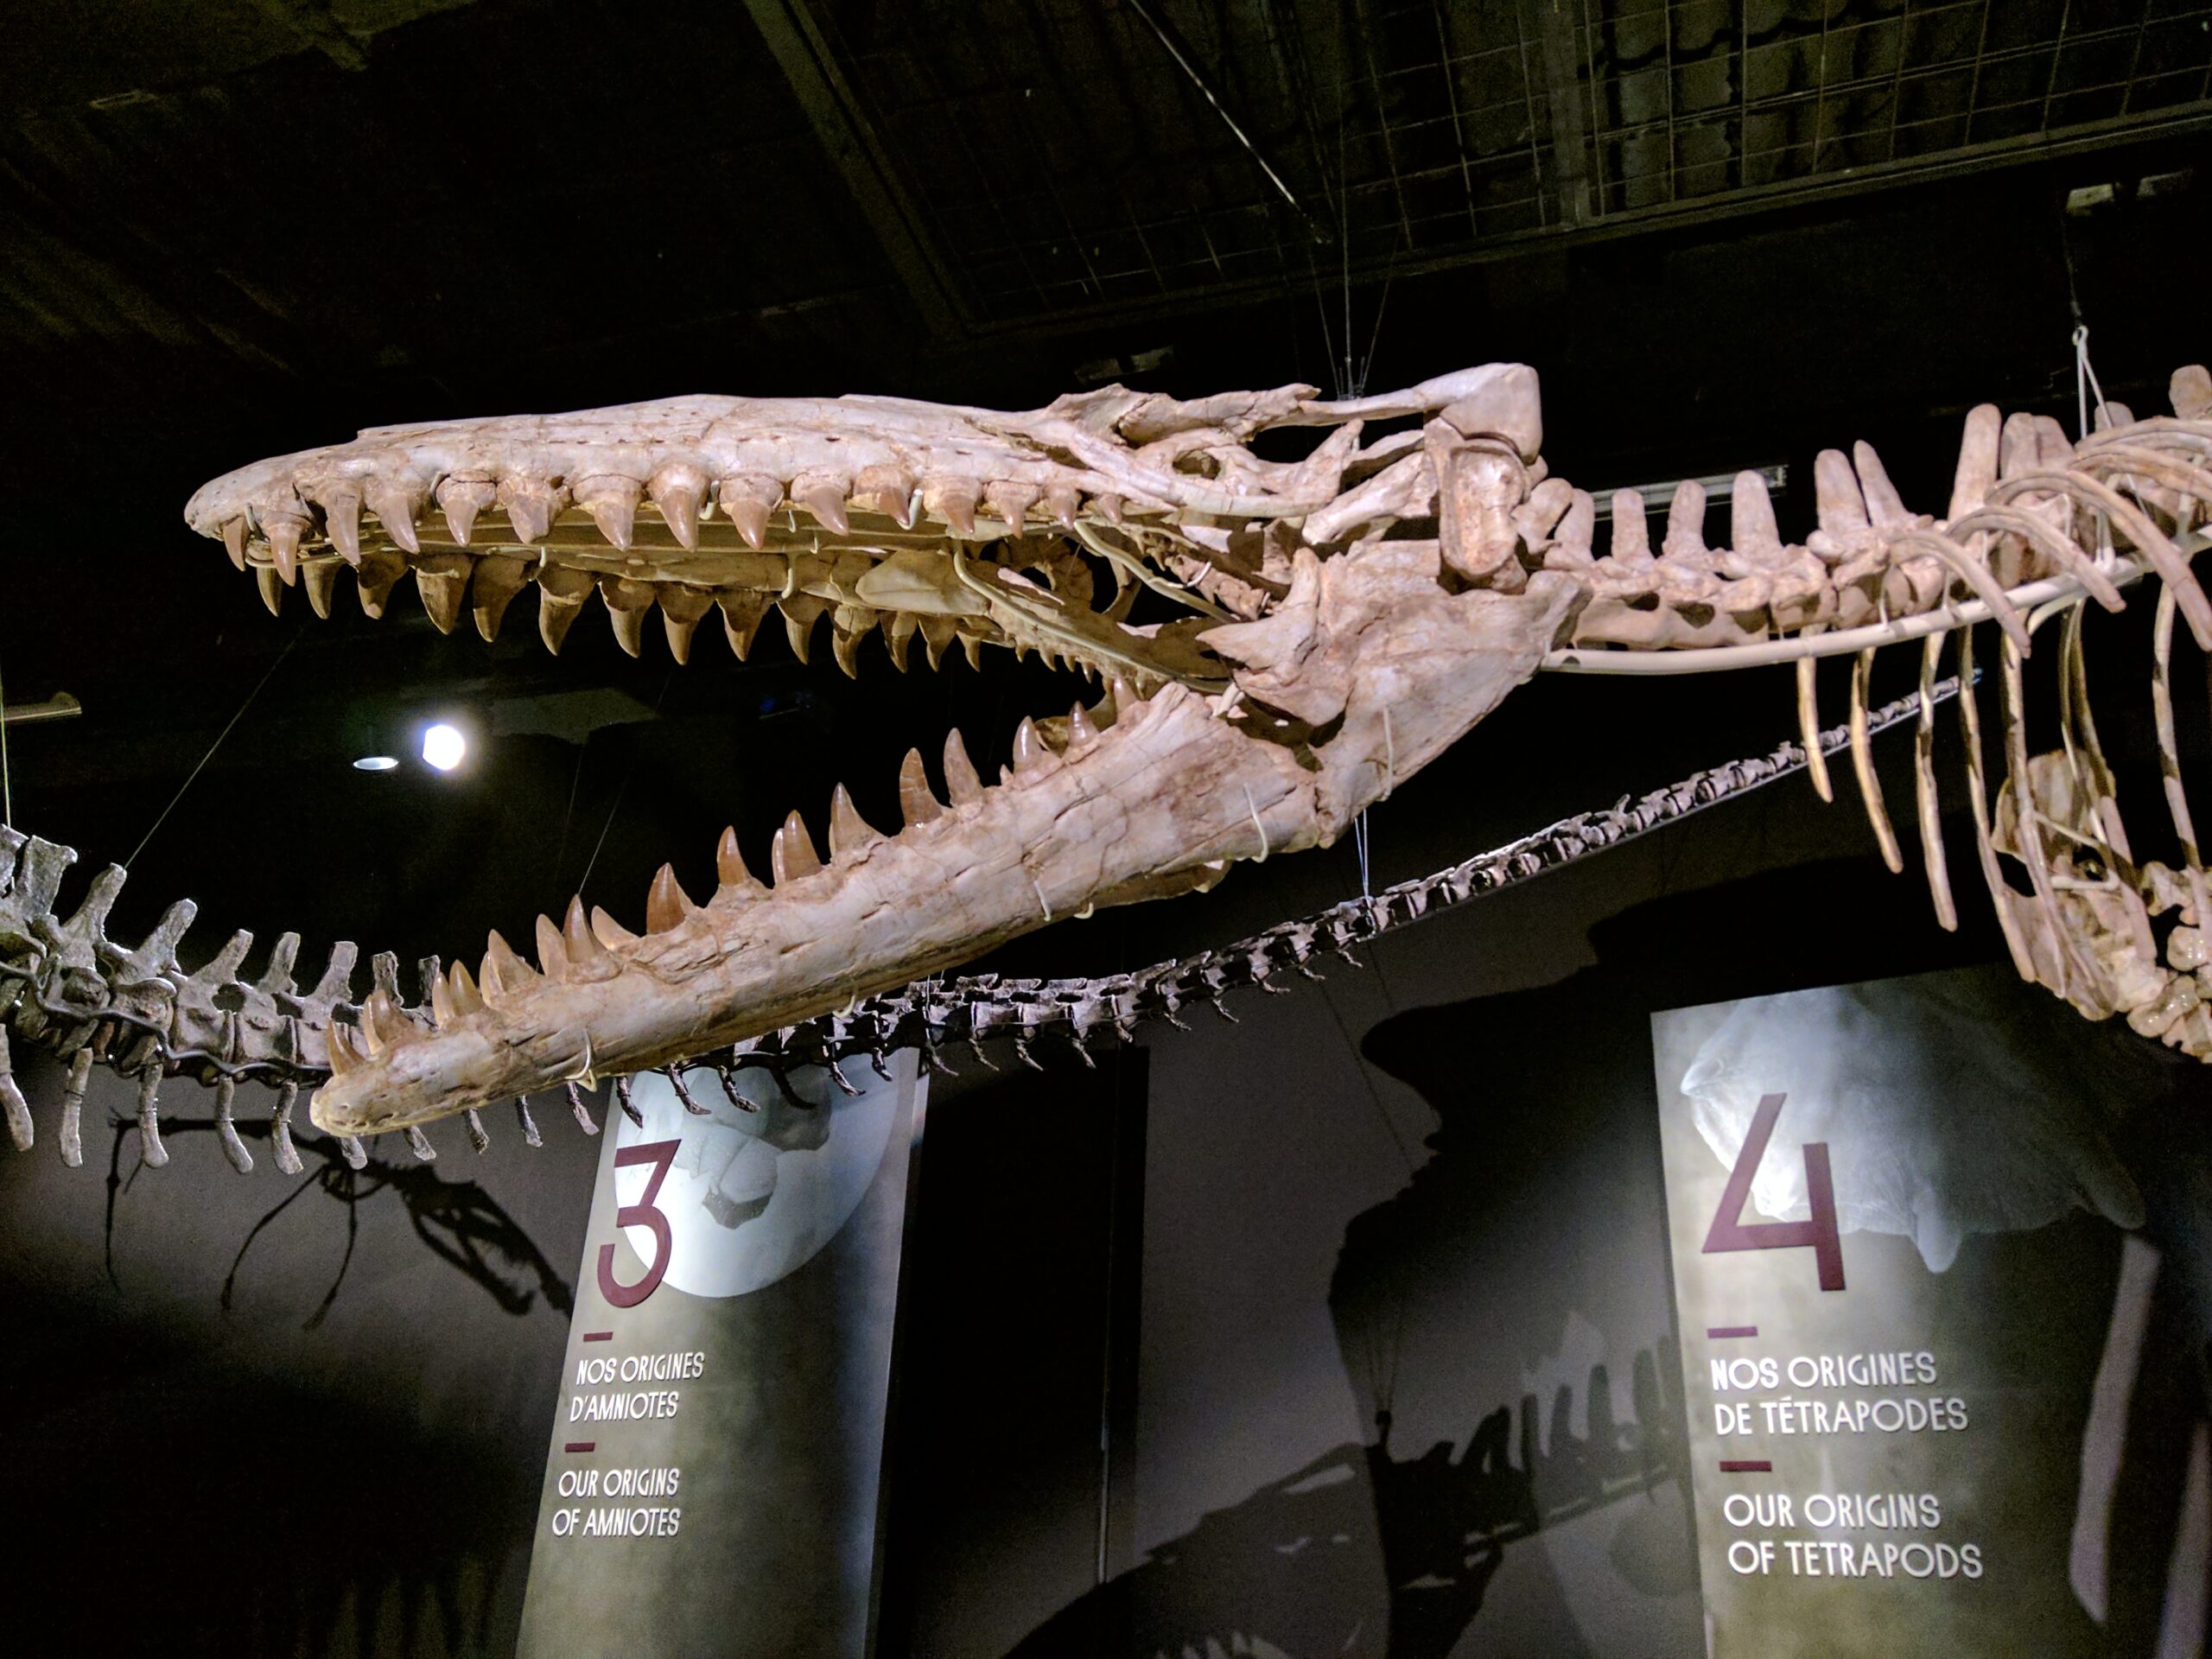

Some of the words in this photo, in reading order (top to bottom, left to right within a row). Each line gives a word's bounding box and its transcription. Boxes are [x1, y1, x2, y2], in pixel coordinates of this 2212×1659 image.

[1701, 1091, 1846, 1293] 4
[596, 1138, 682, 1308] 3
[576, 1357, 616, 1385] NOS
[620, 1351, 705, 1382] ORIGINES
[1711, 1357, 1779, 1390] NOS
[1788, 1351, 1937, 1388] ORIGINES
[569, 1390, 680, 1422] D'AMNIOTES
[1714, 1401, 1752, 1436] DE
[1760, 1395, 1968, 1434] TÉTRAPODES
[558, 1469, 598, 1499] OUR
[602, 1468, 680, 1498] ORIGINS
[551, 1508, 582, 1538] OF
[582, 1507, 681, 1538] AMNIOTES
[1724, 1495, 1794, 1529] OUR
[1804, 1495, 1942, 1529] ORIGINS
[1727, 1542, 1777, 1575] OF
[1784, 1542, 1983, 1580] TETRAPODS
